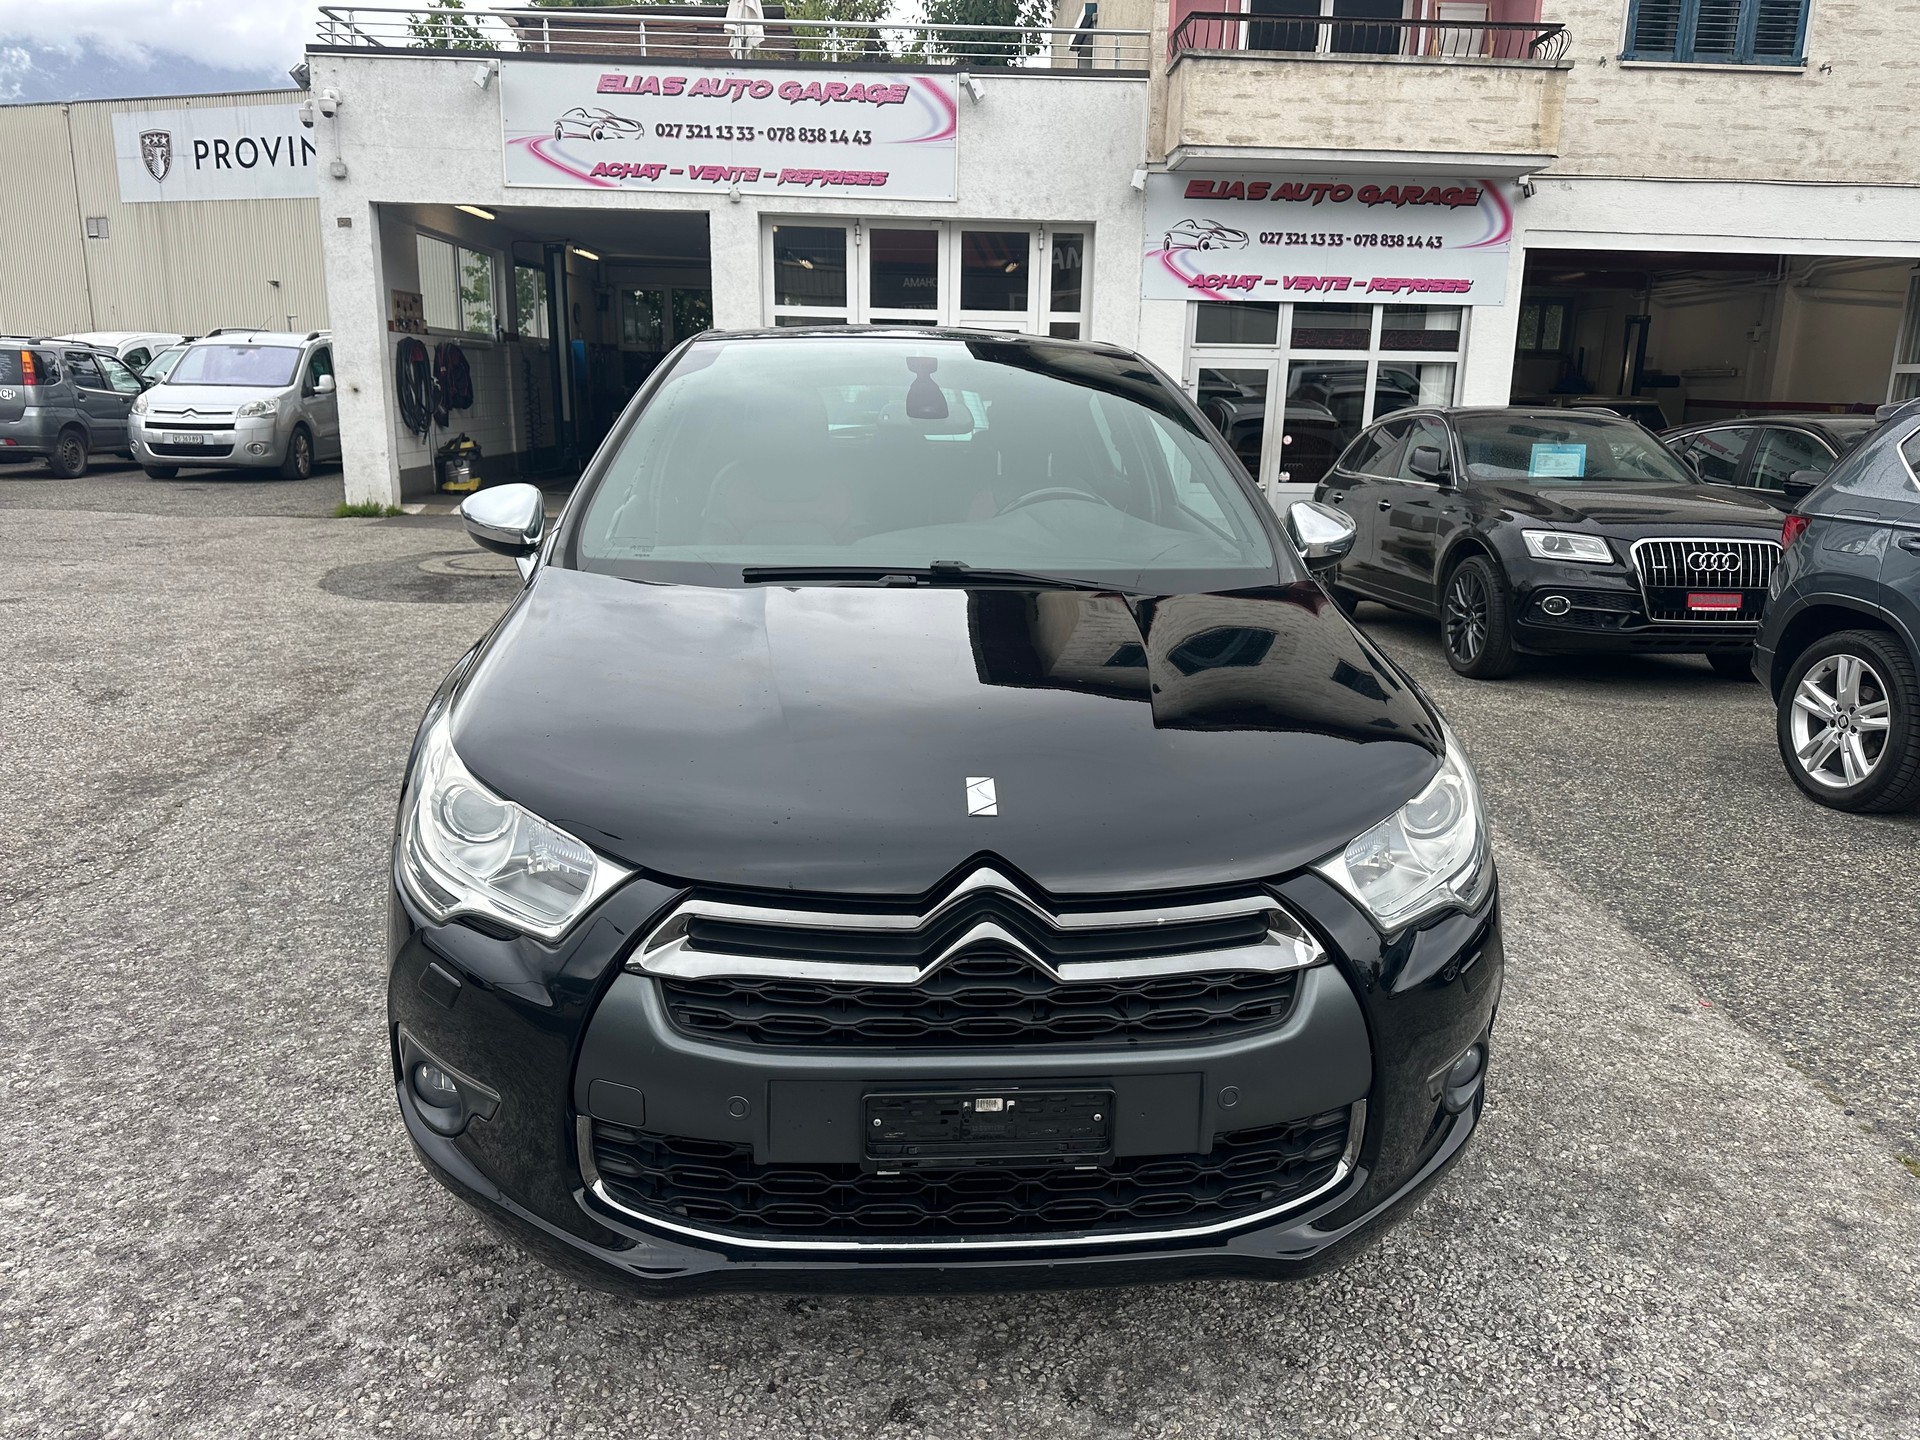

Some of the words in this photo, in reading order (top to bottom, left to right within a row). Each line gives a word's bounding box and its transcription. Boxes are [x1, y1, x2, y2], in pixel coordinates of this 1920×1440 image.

[597, 73, 688, 96] ELIAS
[688, 76, 774, 103] AUTO
[777, 79, 910, 107] GARAGE
[655, 123, 683, 139] 027
[685, 124, 713, 140] 321
[715, 125, 733, 140] 13
[736, 126, 755, 141] 33
[767, 127, 795, 143] 078
[798, 128, 826, 143] 838
[830, 129, 849, 145] 14
[852, 130, 872, 145] 43
[590, 162, 667, 181] ACHAT
[688, 165, 761, 184] VENTE
[777, 168, 889, 188] REPRISES
[1184, 180, 1271, 200] ELIAS
[1270, 182, 1353, 206] AUTO
[1357, 185, 1484, 210] GARAGE
[1259, 232, 1283, 246] 027
[1284, 232, 1307, 246] 321
[1310, 233, 1326, 246] 13
[1327, 233, 1343, 247] 33
[1354, 234, 1377, 247] 078
[1380, 234, 1404, 248] 838
[1407, 235, 1423, 248] 14
[1426, 236, 1443, 249] 43
[1188, 274, 1262, 292] ACHAT
[1283, 276, 1352, 294] VENTE
[1366, 277, 1474, 295] REPRISES
[1, 389, 14, 398] CH
